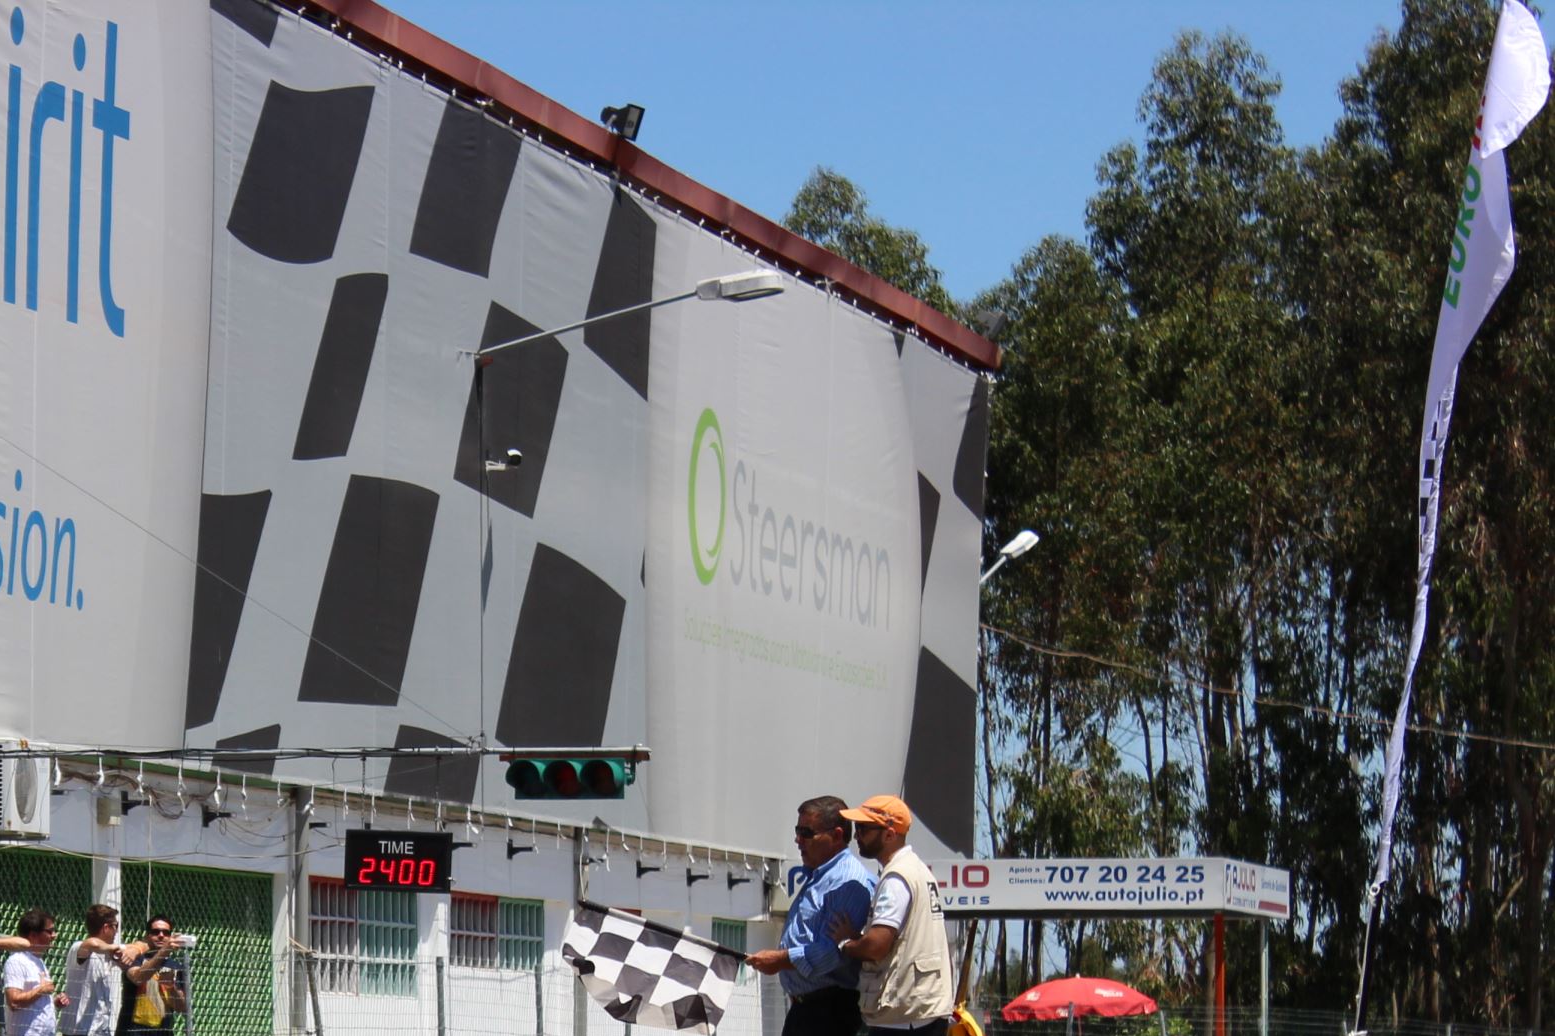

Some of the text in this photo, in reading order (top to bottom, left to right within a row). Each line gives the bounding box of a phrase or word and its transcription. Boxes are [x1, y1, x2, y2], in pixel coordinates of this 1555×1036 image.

[1444, 163, 1482, 310] EURO
[730, 459, 891, 631] Steersman
[378, 840, 415, 855] TIME
[358, 857, 437, 887] 2400
[1008, 866, 1033, 875] Apoio
[1044, 865, 1205, 884] 707 20 24 25
[1045, 886, 1205, 905] www.autojulio.pt
